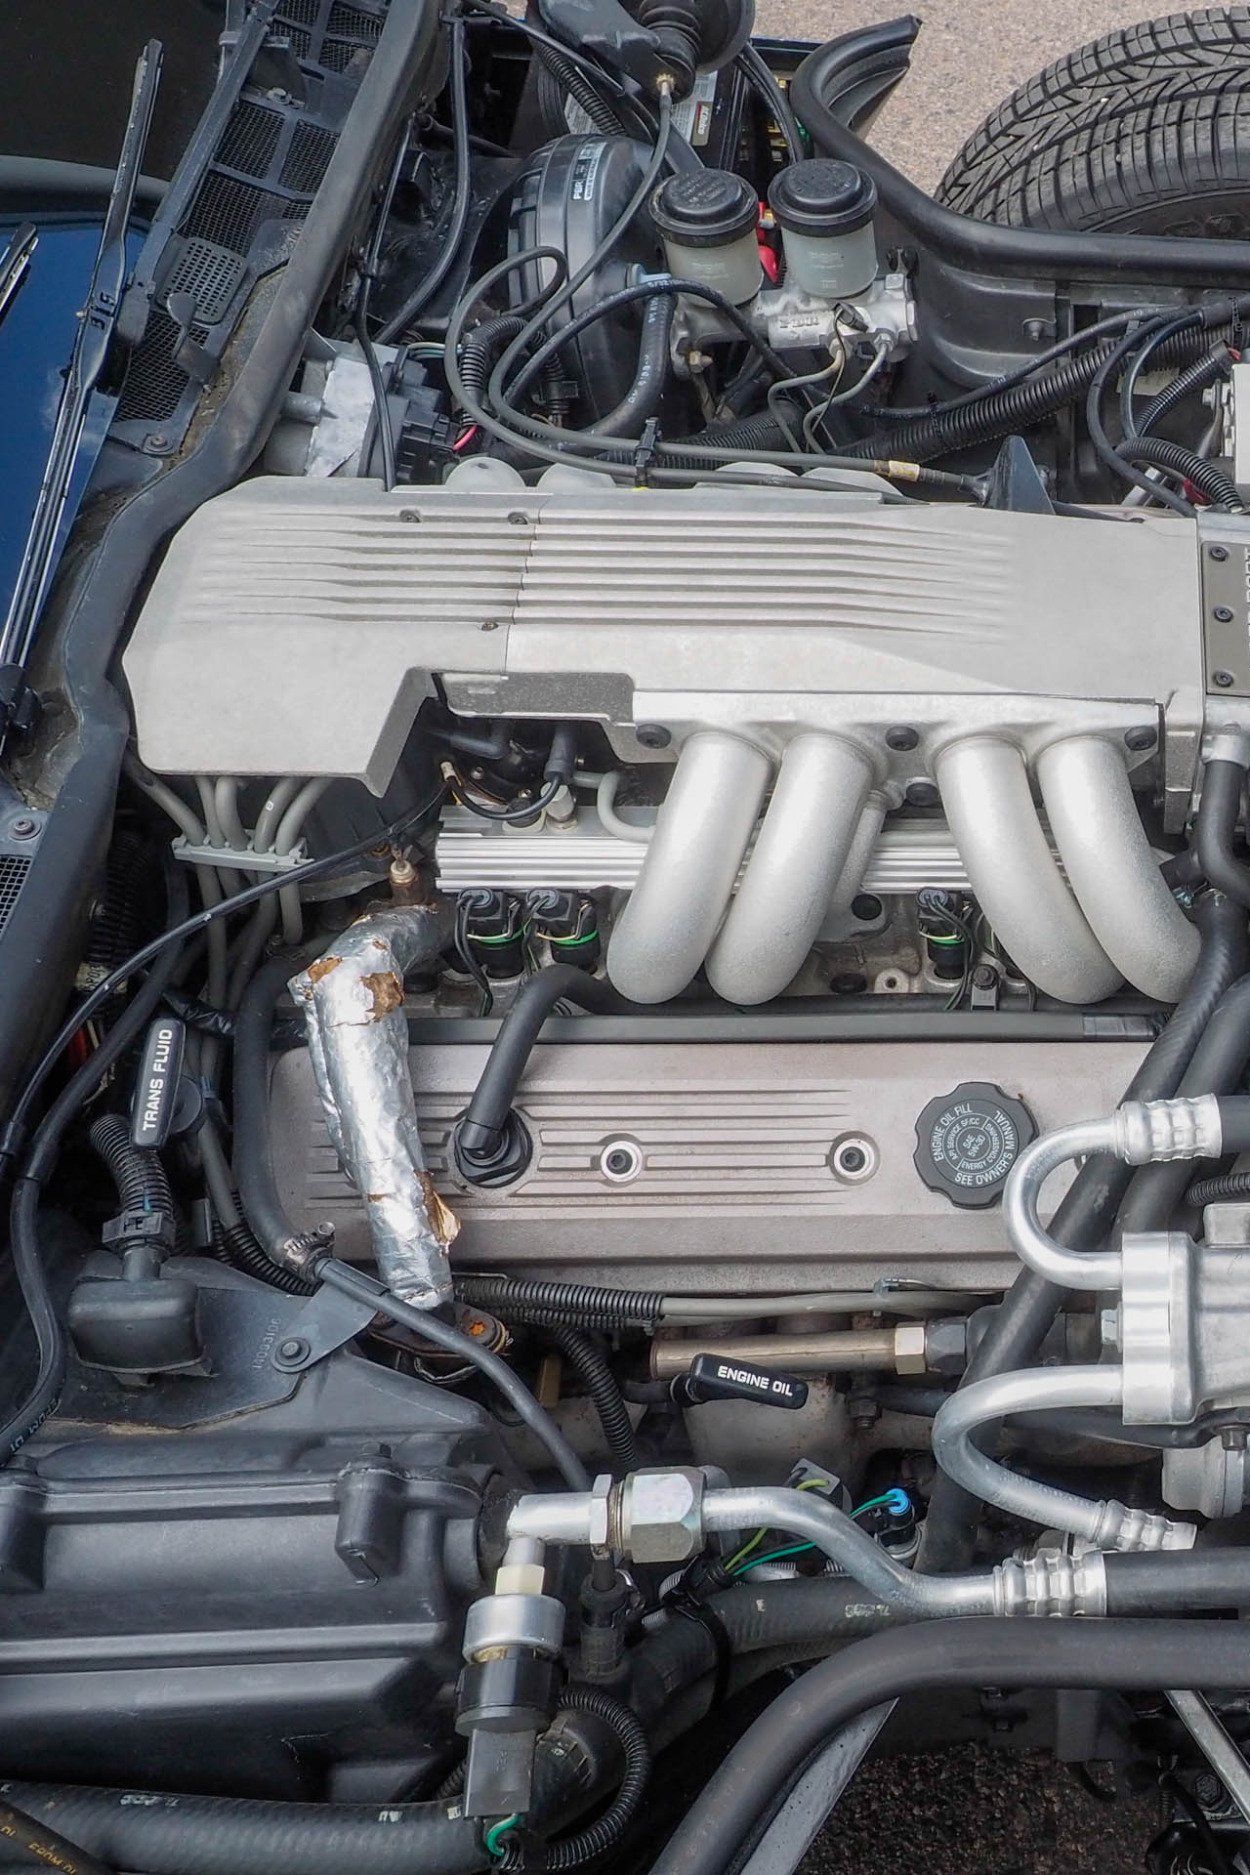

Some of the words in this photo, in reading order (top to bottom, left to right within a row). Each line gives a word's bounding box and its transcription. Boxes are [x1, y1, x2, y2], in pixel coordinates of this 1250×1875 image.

[152, 1029, 173, 1073] FLUID
[142, 1078, 164, 1131] TRANS
[931, 1125, 945, 1162] ENGINE
[940, 1112, 955, 1126] OIL
[954, 1102, 973, 1117] FILL
[946, 1123, 961, 1149] SERVICE
[962, 1134, 976, 1149] SAE
[993, 1110, 1015, 1150] MANUAL
[954, 1172, 973, 1186] SEE
[975, 1152, 1013, 1185] OWNER'S
[717, 1365, 770, 1390] ENGINE
[771, 1381, 793, 1397] OIL
